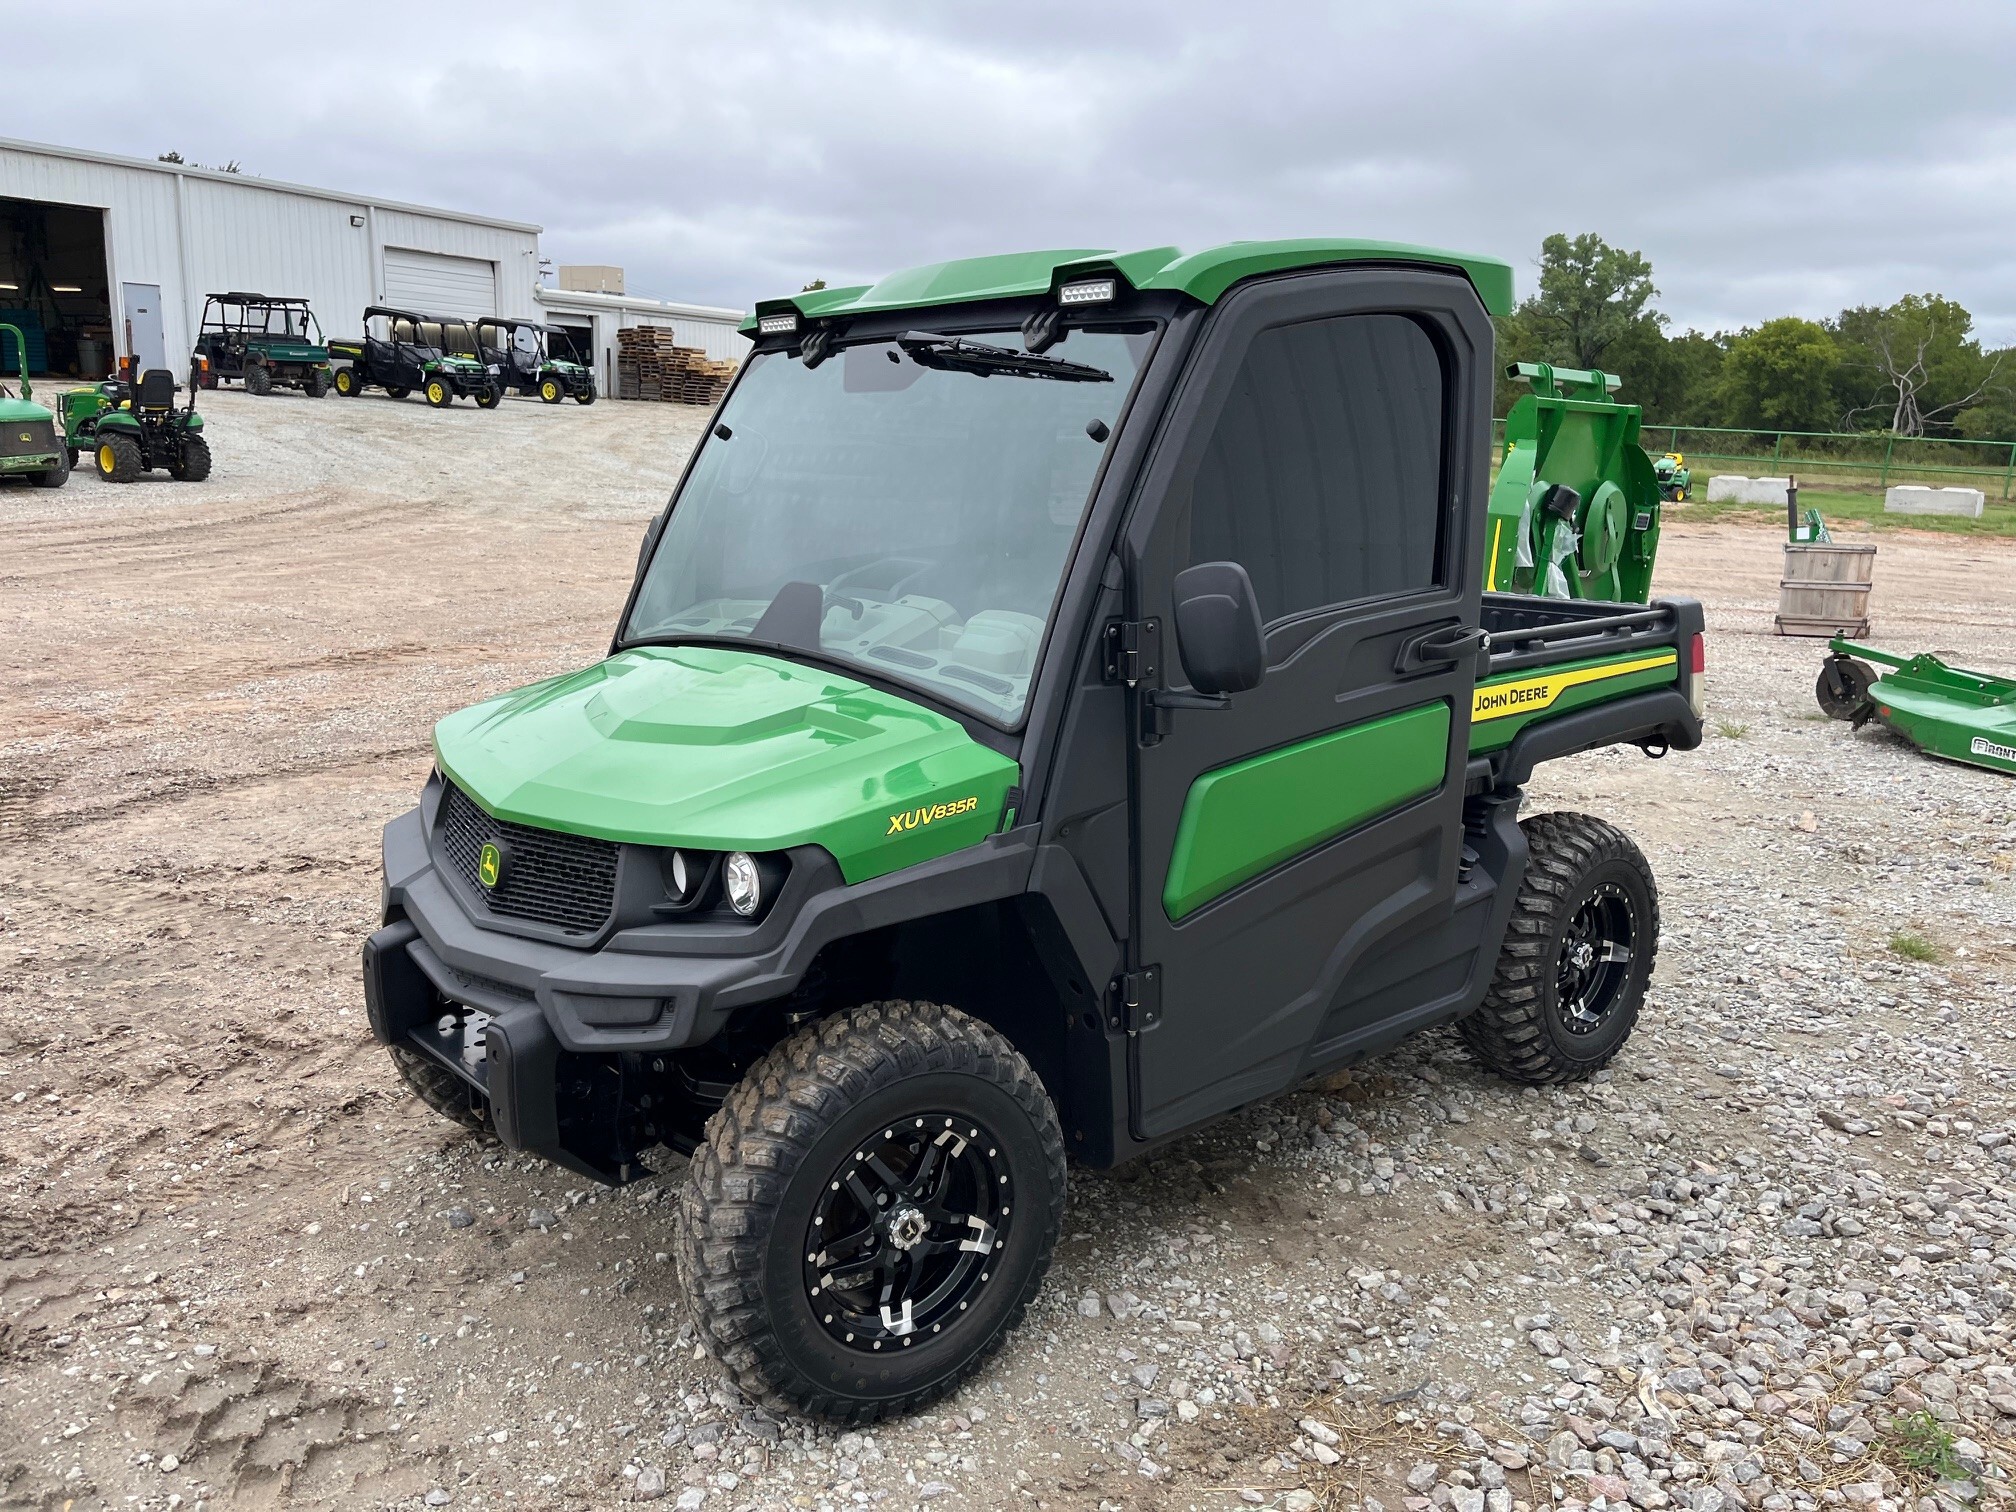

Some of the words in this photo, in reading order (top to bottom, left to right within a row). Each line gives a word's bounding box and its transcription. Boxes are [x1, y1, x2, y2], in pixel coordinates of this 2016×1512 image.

[1475, 693, 1507, 711] JOHN
[1510, 686, 1549, 705] DEERE
[886, 796, 978, 836] XUV835R
